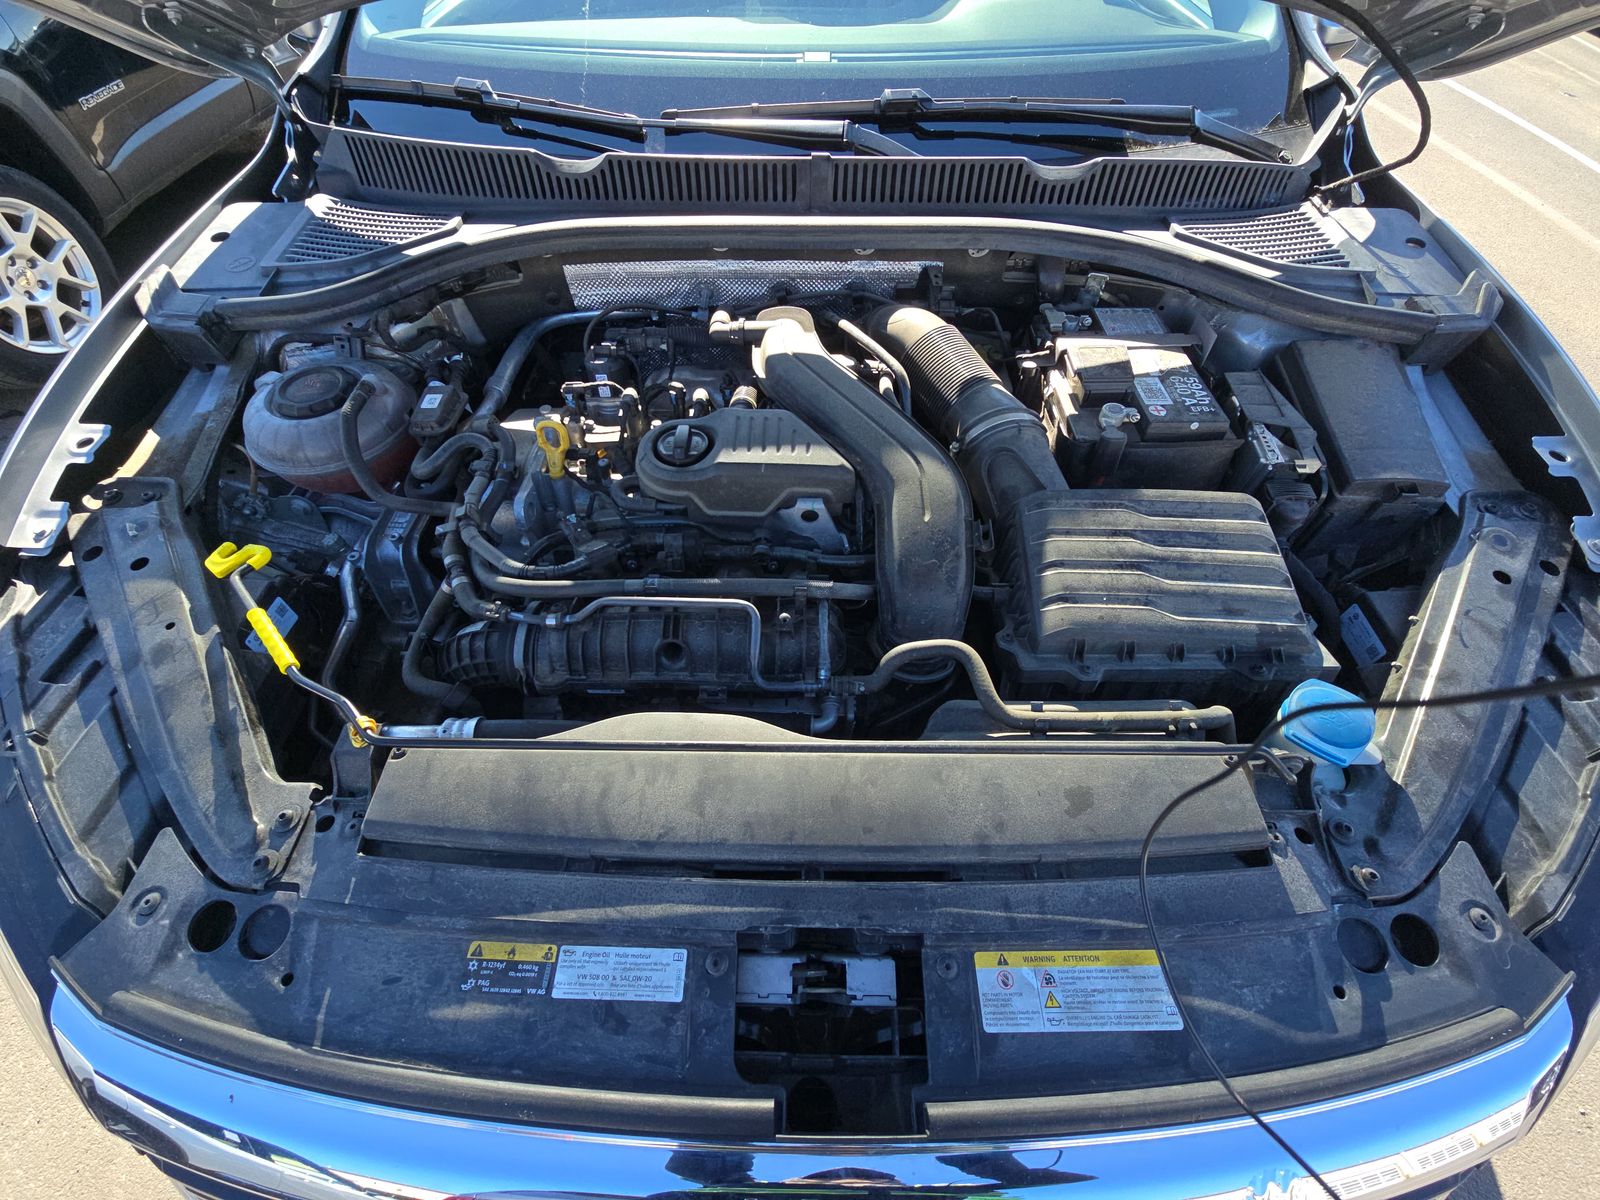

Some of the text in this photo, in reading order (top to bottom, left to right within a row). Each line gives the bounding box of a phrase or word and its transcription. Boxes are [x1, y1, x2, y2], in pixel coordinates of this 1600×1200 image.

[79, 80, 125, 110] RENEGADE
[1170, 376, 1191, 395] 640
[1182, 397, 1198, 406] A
[1184, 377, 1211, 405] 59Ah
[582, 952, 601, 960] Engine
[482, 961, 506, 971] R-1234yf
[532, 964, 539, 972] kg
[477, 980, 490, 988] PAG
